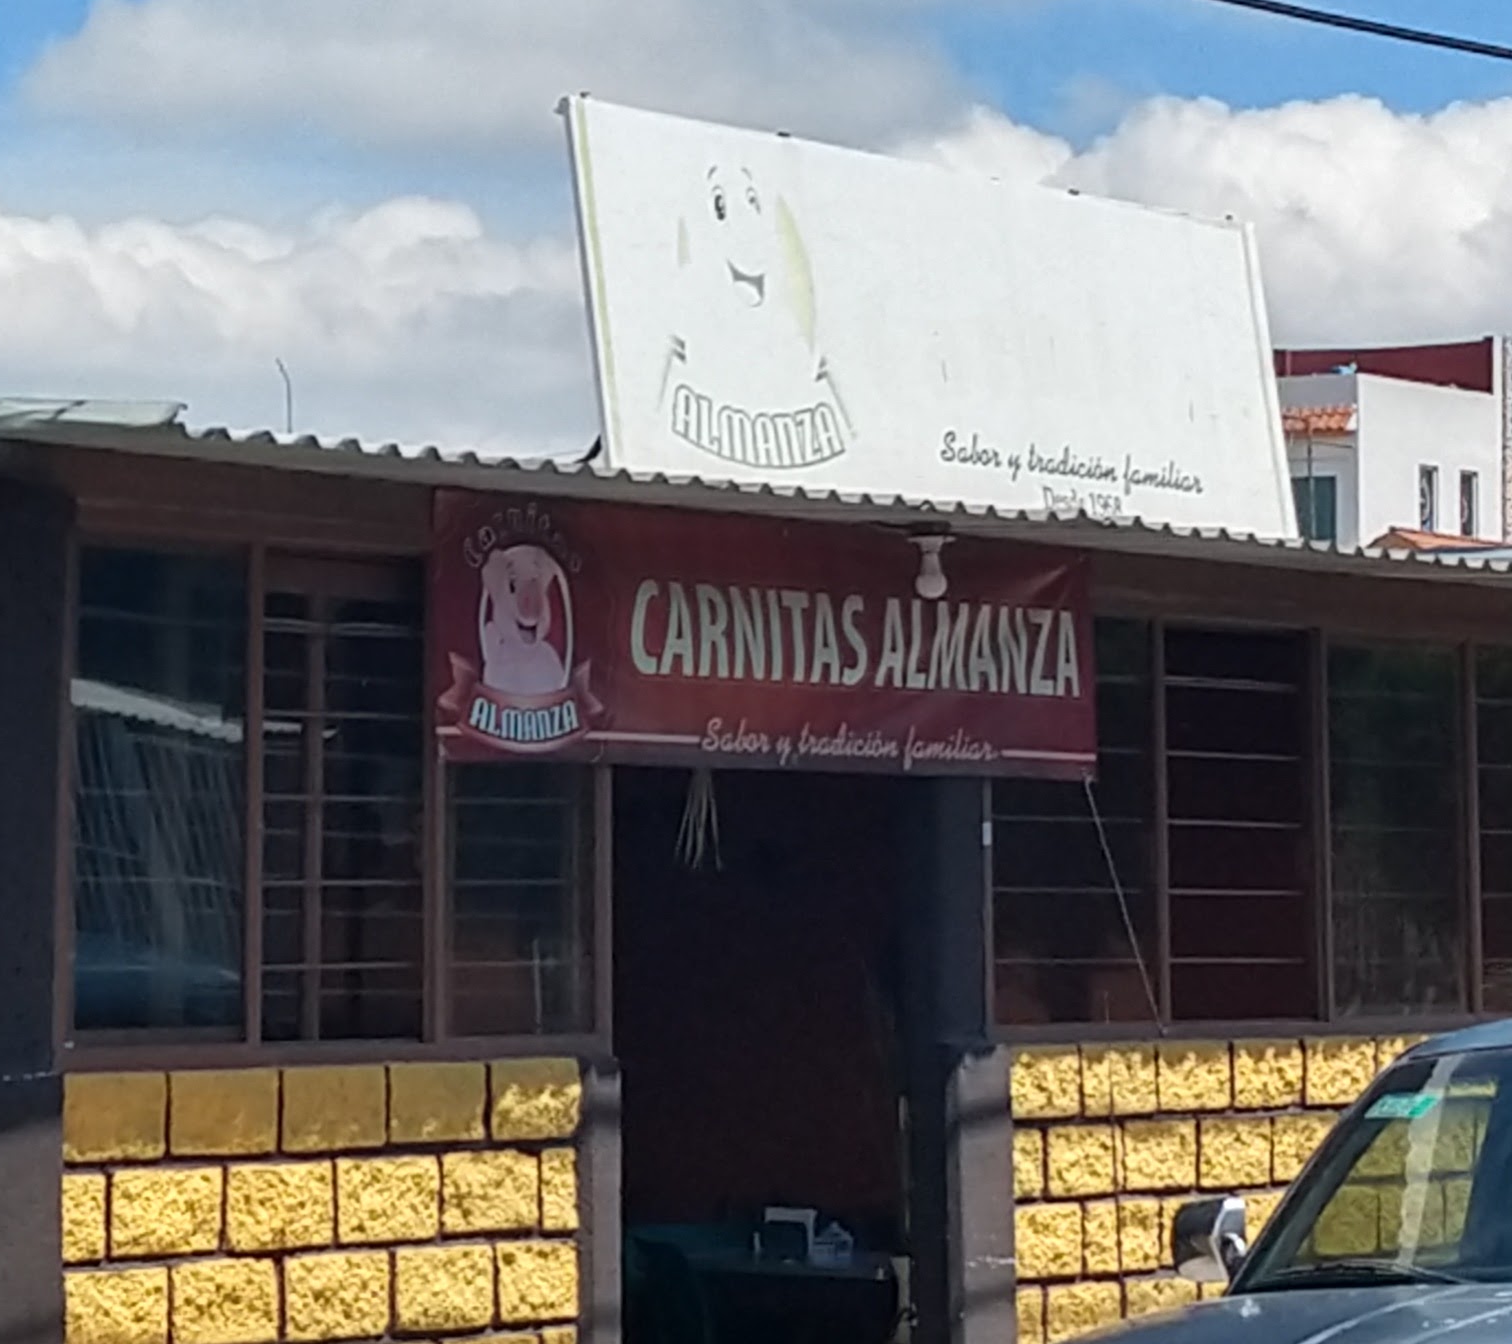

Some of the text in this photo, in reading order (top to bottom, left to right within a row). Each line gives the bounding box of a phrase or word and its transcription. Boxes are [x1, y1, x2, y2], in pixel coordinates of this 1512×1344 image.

[672, 384, 845, 469] ALMANZA
[941, 431, 1203, 495] Sabor y tradición familiar
[630, 579, 1080, 698] CARNITAS ALMANZA
[469, 696, 580, 743] ALMANZA
[701, 717, 770, 754] Sabor
[776, 734, 791, 767] y
[797, 721, 899, 758] tradición
